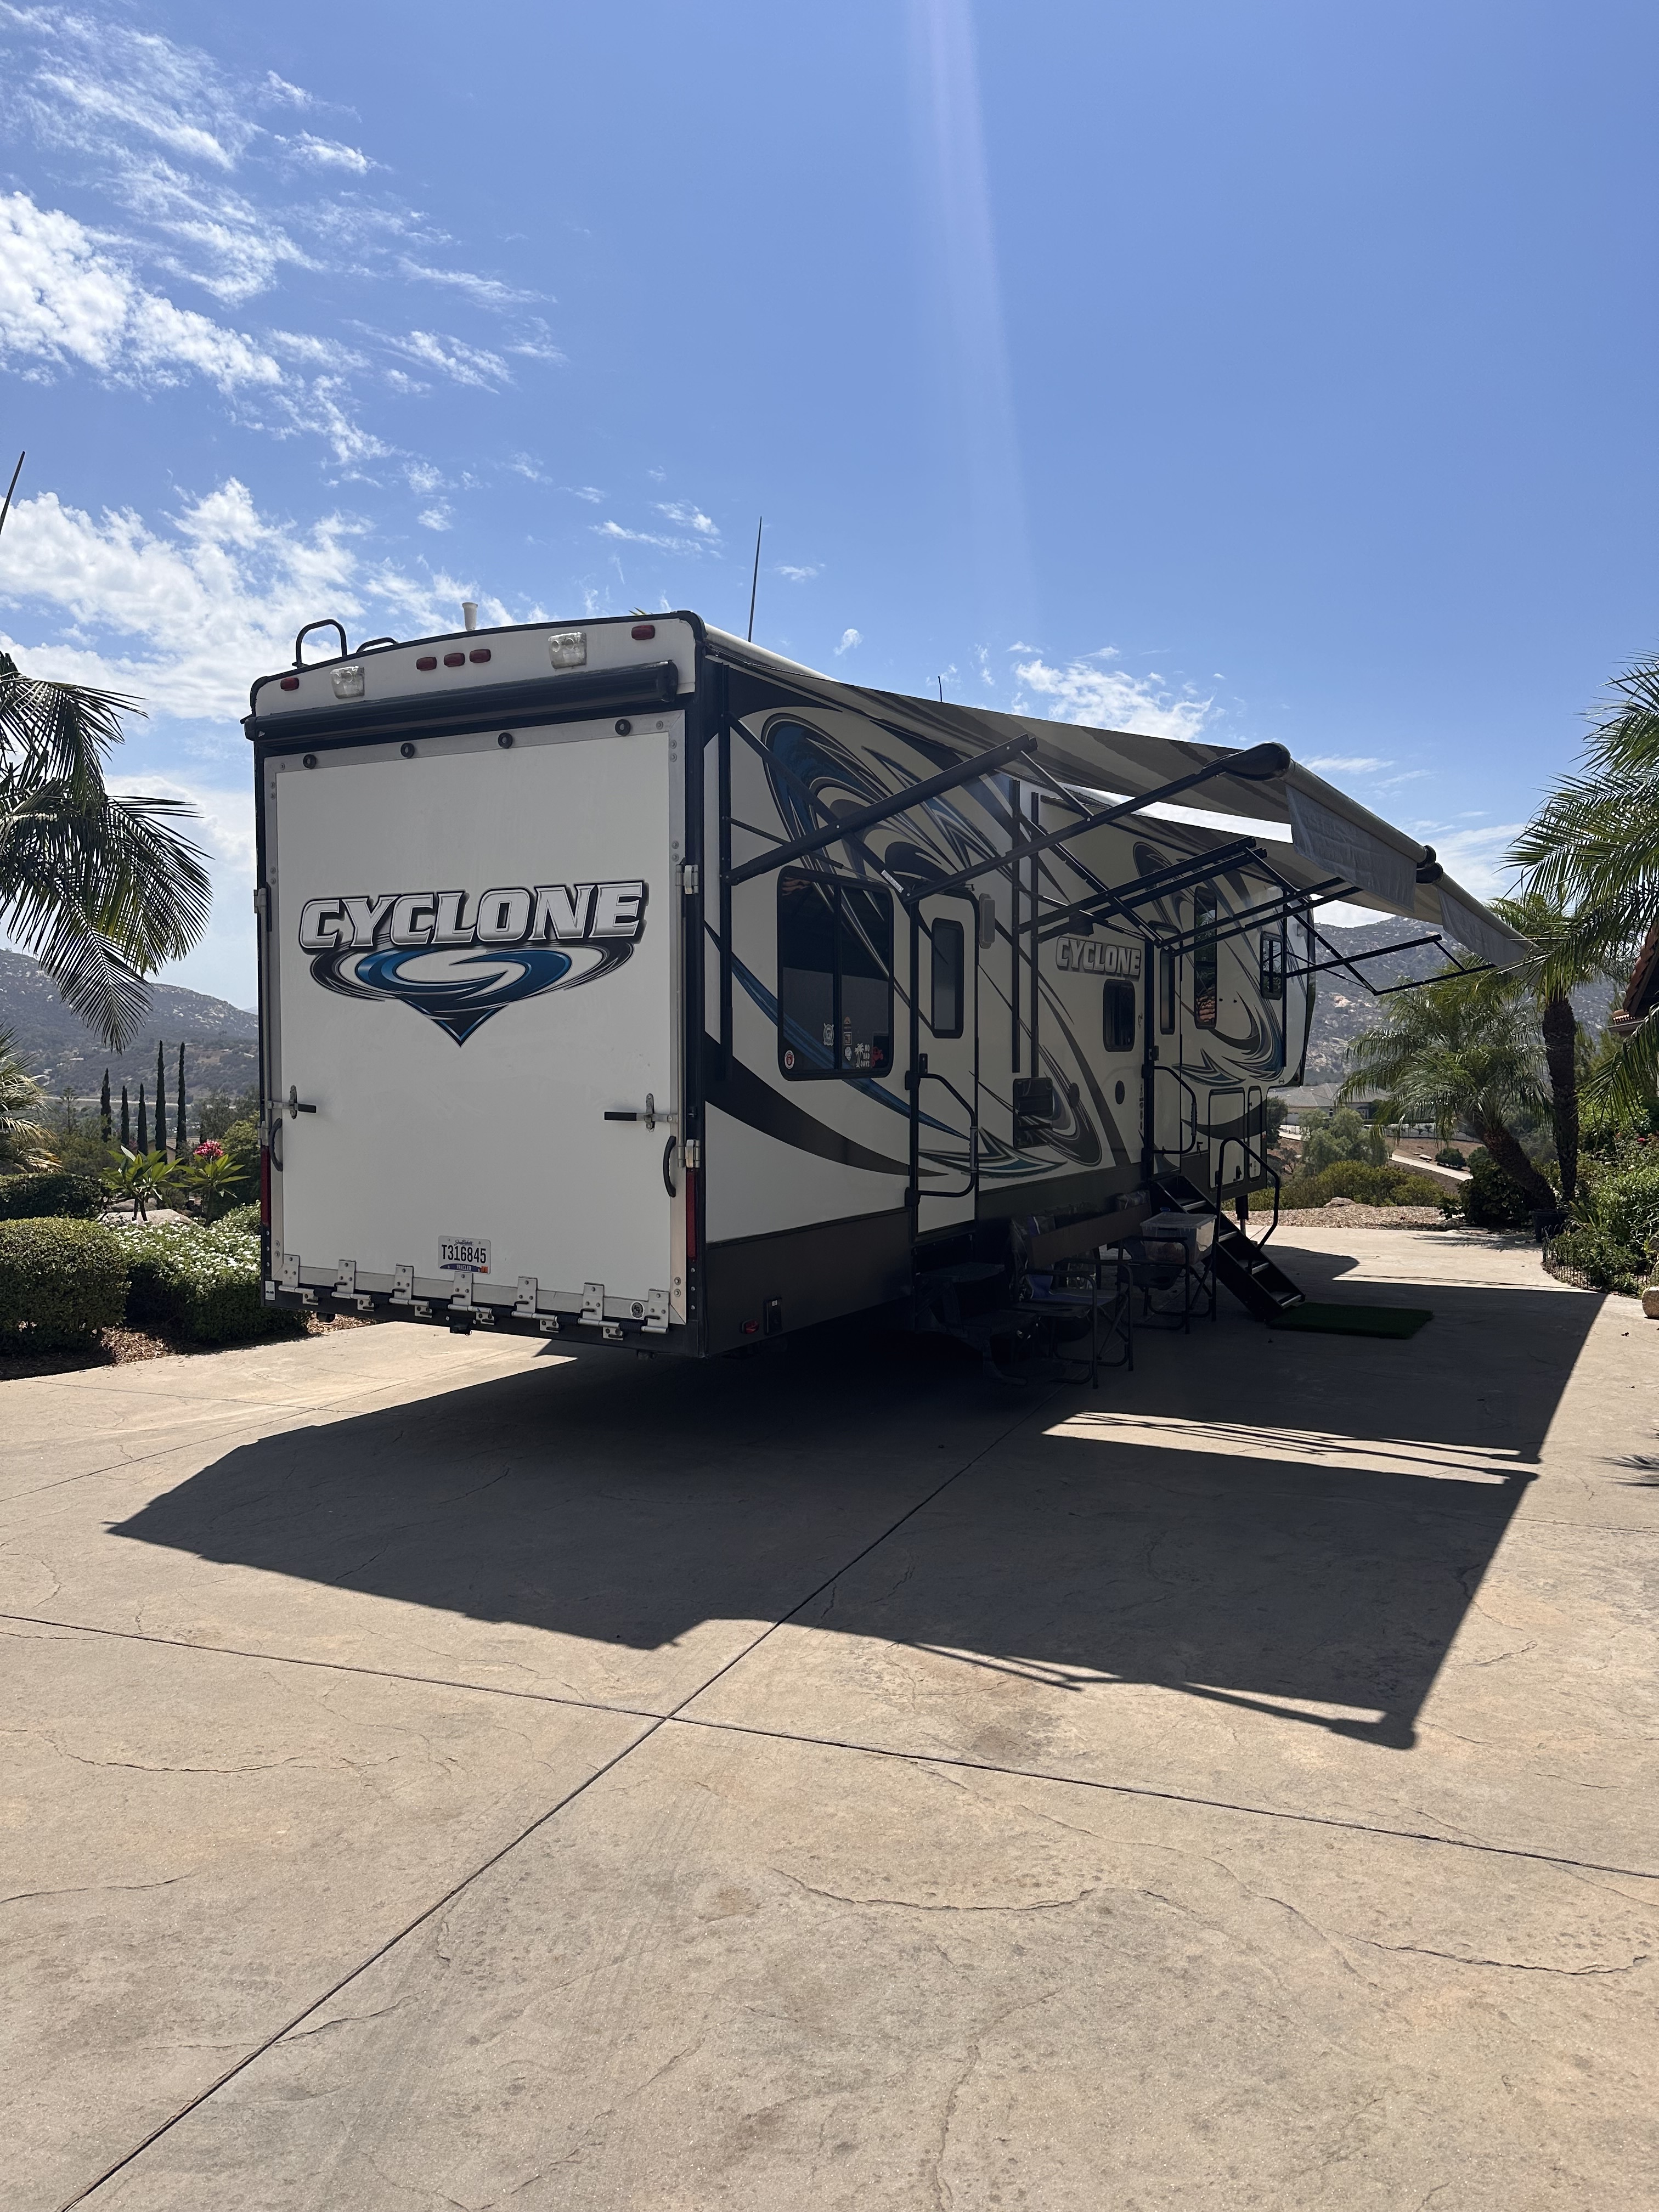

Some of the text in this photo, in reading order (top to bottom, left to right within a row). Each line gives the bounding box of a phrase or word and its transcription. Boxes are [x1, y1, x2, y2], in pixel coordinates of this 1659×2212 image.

[299, 879, 648, 953] CYCLONE
[1056, 936, 1142, 981] CYCLONE
[441, 1244, 486, 1263] T316845
